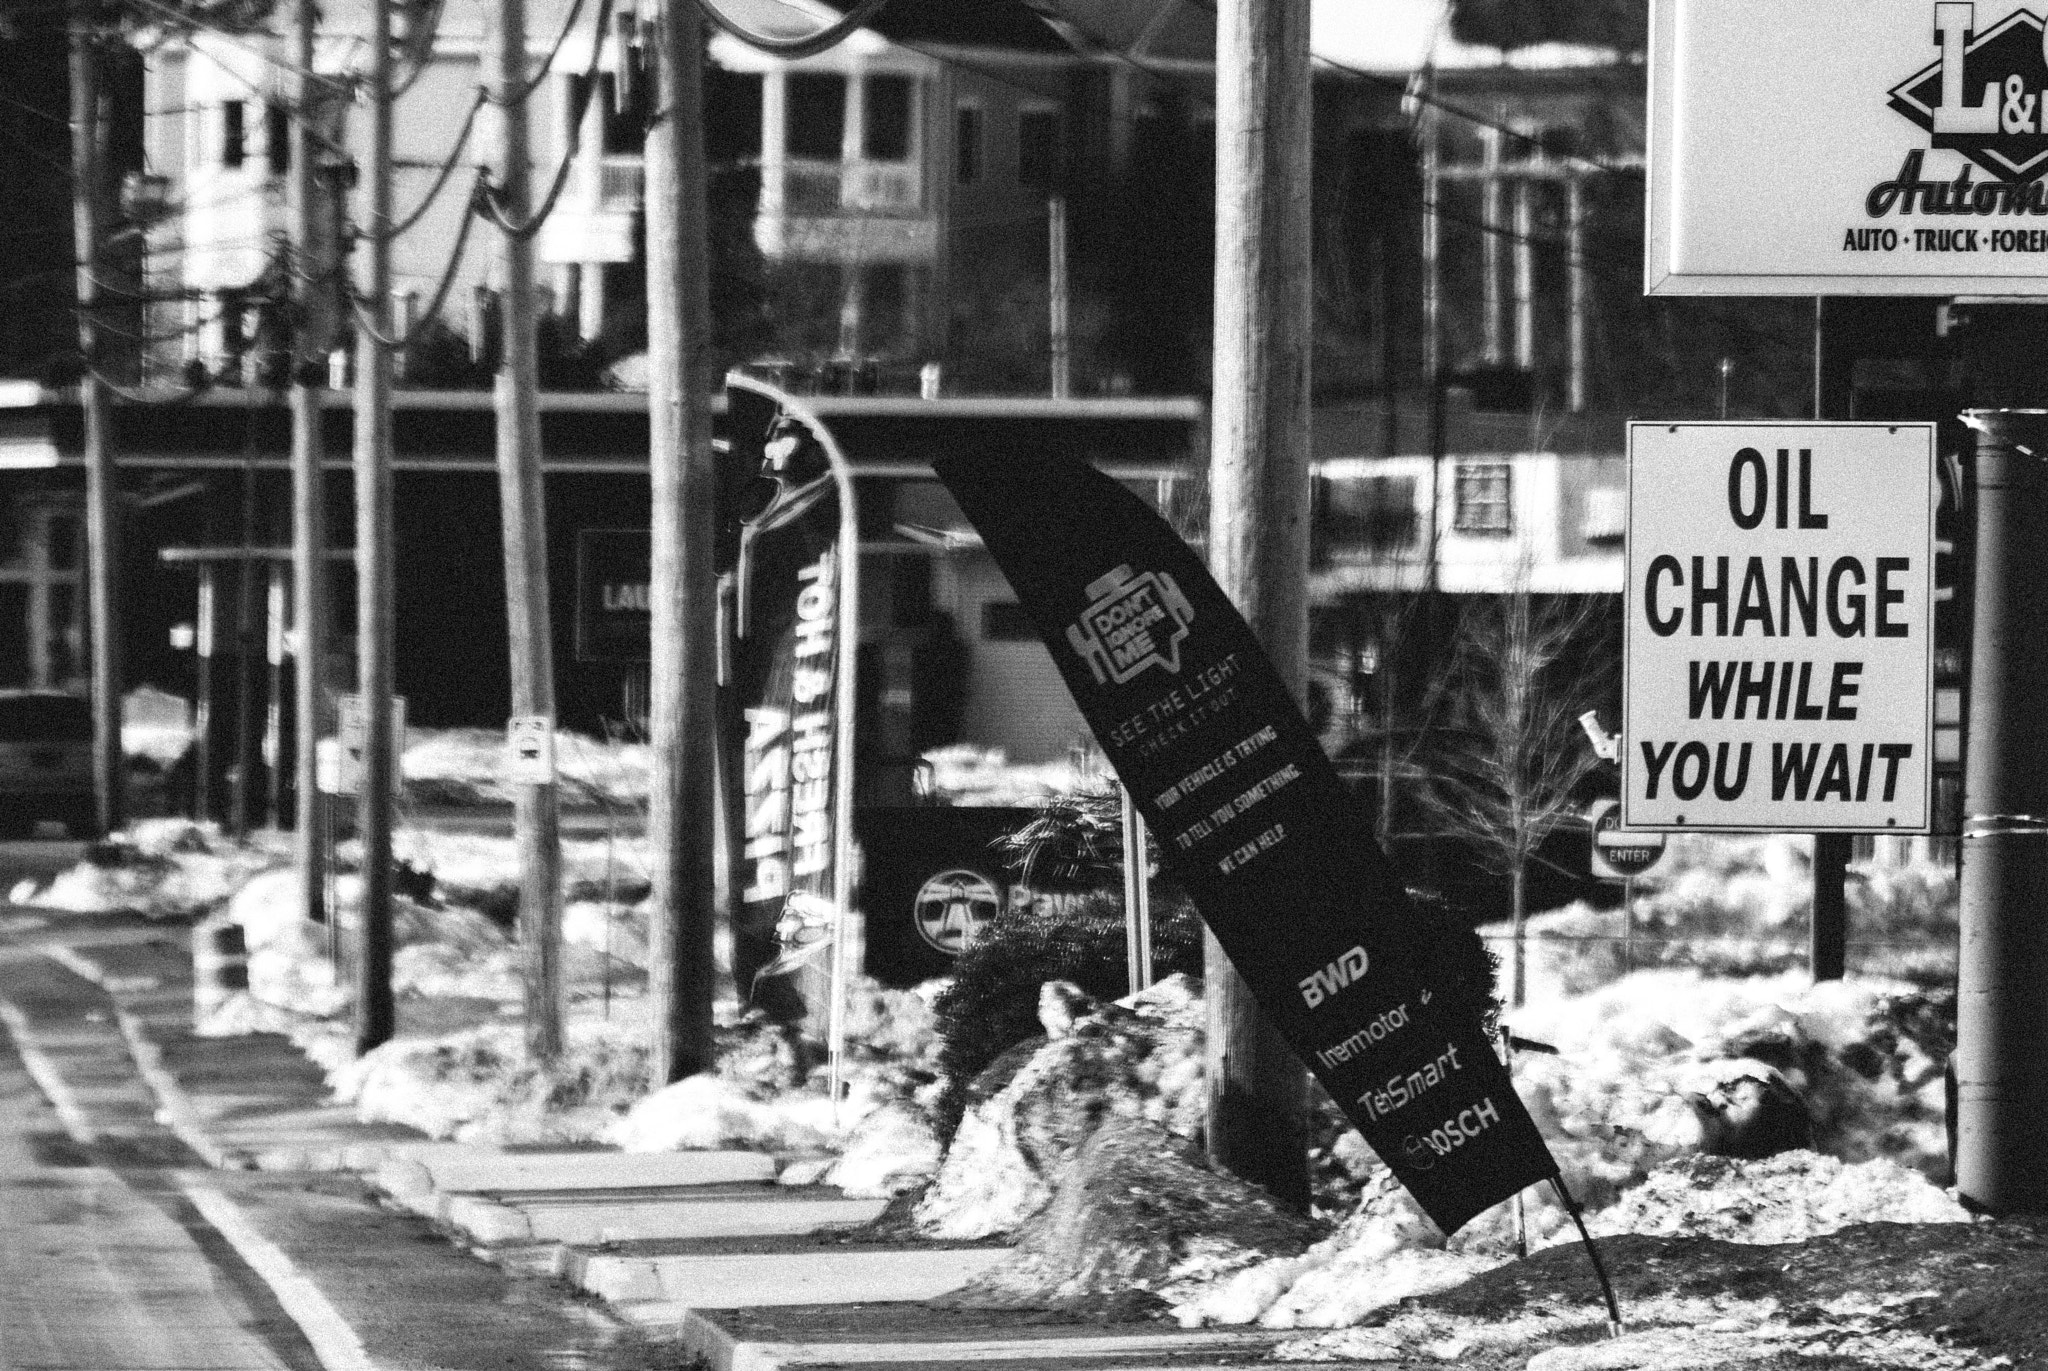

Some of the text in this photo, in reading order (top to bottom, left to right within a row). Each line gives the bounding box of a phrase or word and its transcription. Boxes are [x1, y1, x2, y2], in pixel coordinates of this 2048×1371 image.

[1934, 2, 2048, 134] L&
[1866, 149, 2048, 218] Autom
[1843, 228, 2048, 252] AUTO TRUCK FOREI
[1728, 447, 1828, 530] OIL
[1645, 554, 1910, 638] CHANGE
[1112, 630, 1156, 669] ME
[1110, 653, 1241, 749] SEE THE LIGHT
[1688, 661, 1863, 720] WHILE
[1178, 758, 1225, 794] VEHICLE
[1221, 750, 1237, 767] IS
[1235, 724, 1277, 758] TRYING
[1640, 741, 1913, 802] YOU WAIT
[1176, 832, 1193, 849] TO
[1189, 820, 1212, 840] TELL
[1210, 803, 1235, 826] YOU
[1610, 849, 1650, 863] ENTER
[1218, 856, 1236, 875] WE
[1233, 842, 1259, 864] CAN
[1298, 945, 1369, 1009] BWD
